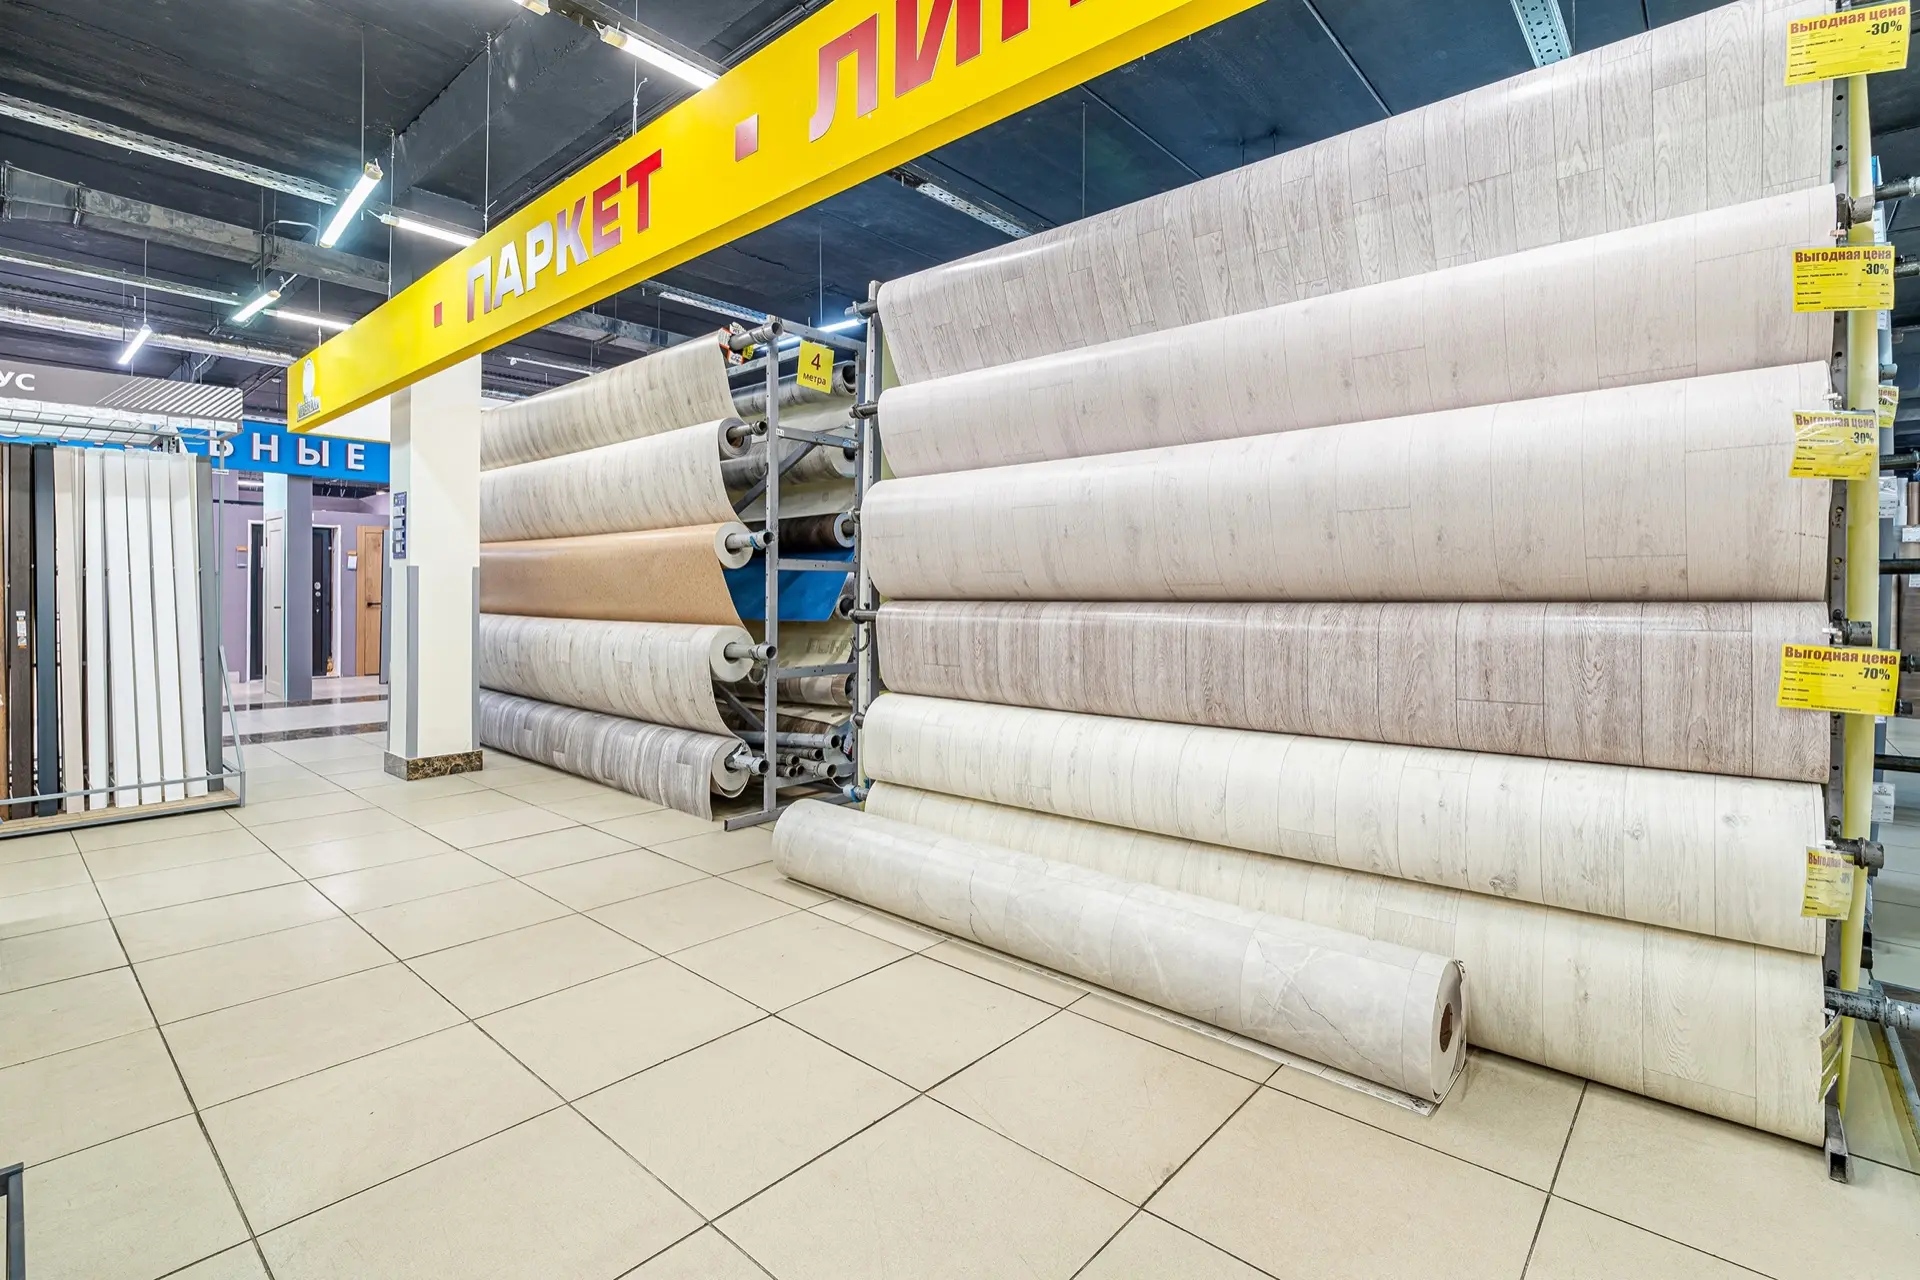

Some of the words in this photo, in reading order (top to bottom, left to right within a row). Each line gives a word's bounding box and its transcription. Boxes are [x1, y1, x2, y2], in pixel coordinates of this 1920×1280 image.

[1790, 12, 1866, 35] Выгодная
[1868, 5, 1907, 21] цена
[1865, 19, 1903, 36] -30%
[808, 0, 1086, 143] ЛИ
[466, 148, 663, 324] ПАРКЕТ
[1795, 250, 1861, 263] Выгодная
[1863, 249, 1892, 261] цена
[1861, 263, 1890, 275] -30%
[811, 353, 821, 371] 4
[802, 372, 827, 386] метра
[1795, 414, 1850, 429] Выгодная
[1851, 416, 1875, 430] цена
[1850, 431, 1875, 444] -30%
[1785, 646, 1859, 663] Выгодная
[1861, 652, 1897, 666] цена
[1858, 666, 1891, 681] -70%
